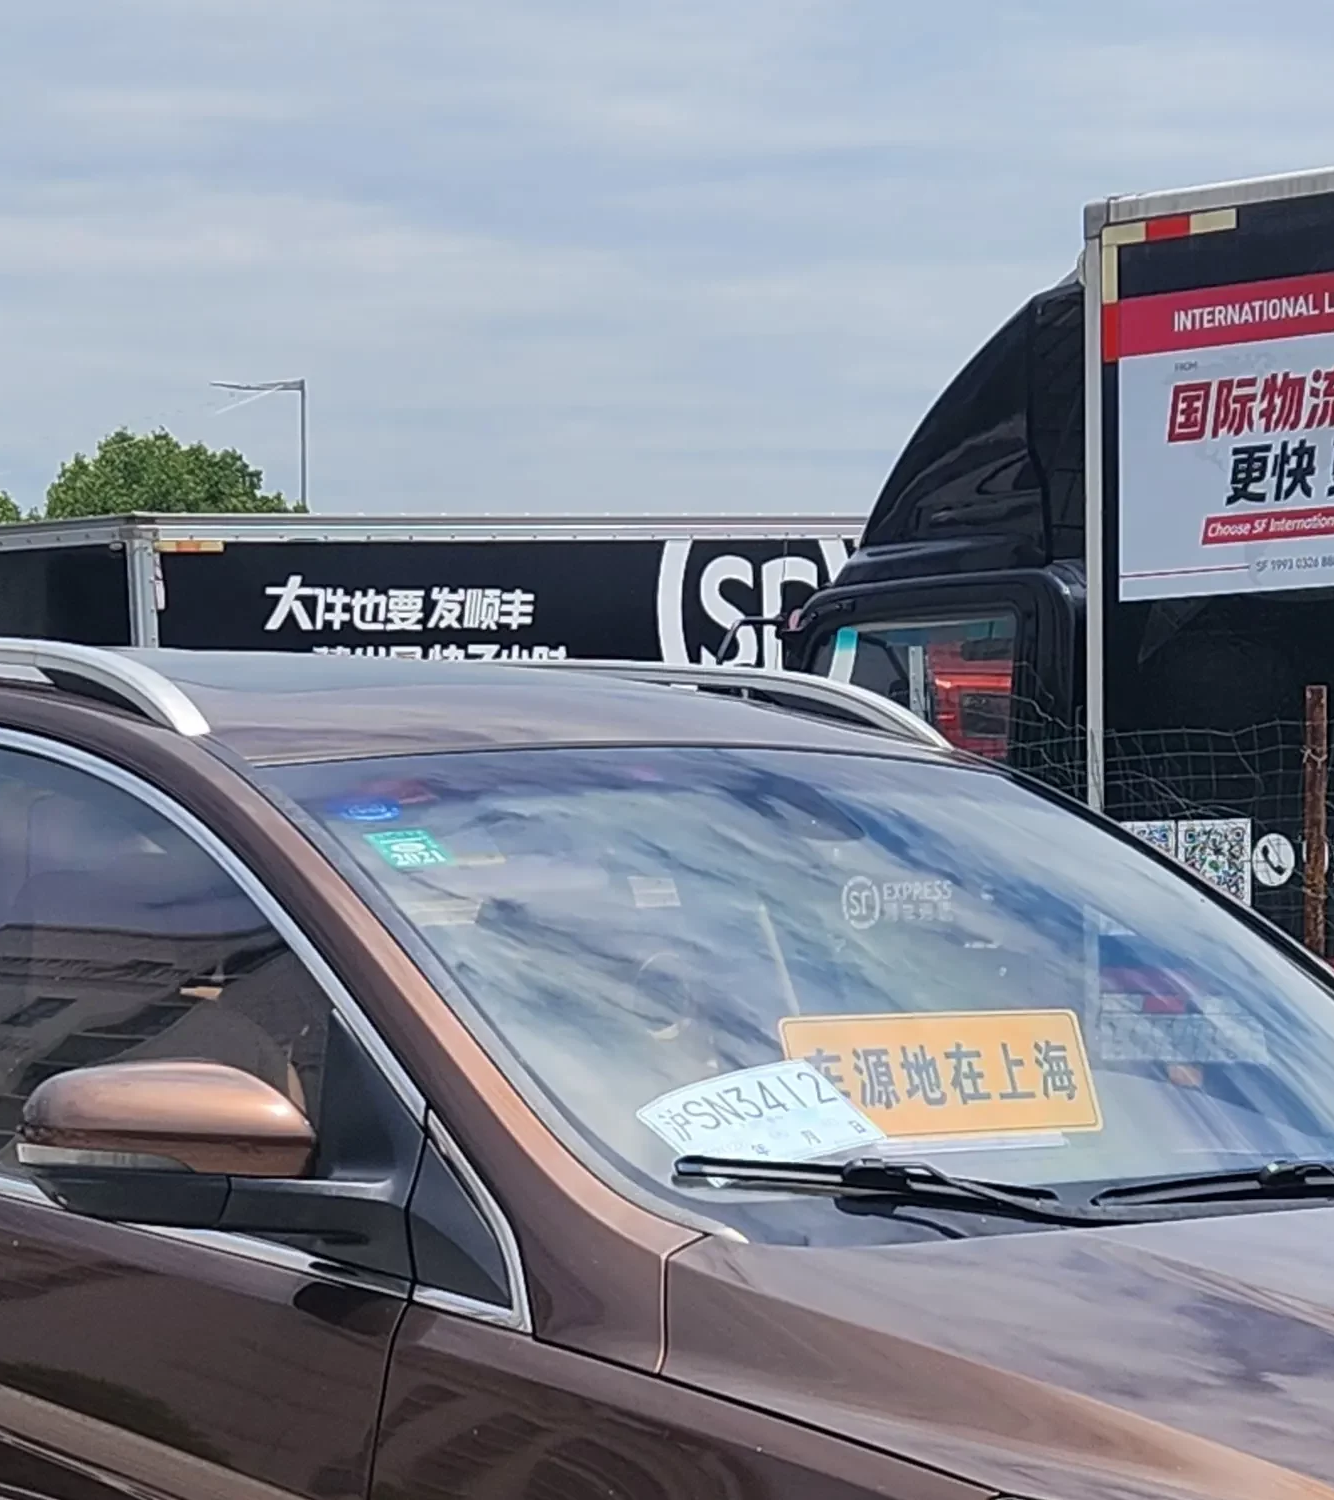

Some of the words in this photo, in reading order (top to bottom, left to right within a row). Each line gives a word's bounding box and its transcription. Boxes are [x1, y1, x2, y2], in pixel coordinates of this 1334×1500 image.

[1173, 293, 1320, 332] INTERNATIONAL
[1225, 438, 1318, 507] 更快
[1206, 522, 1250, 538] Choose
[1252, 520, 1268, 535] SF
[390, 849, 447, 867] 2021
[882, 879, 953, 901] EXPRESS
[658, 1072, 838, 1143] 沪SN3412
